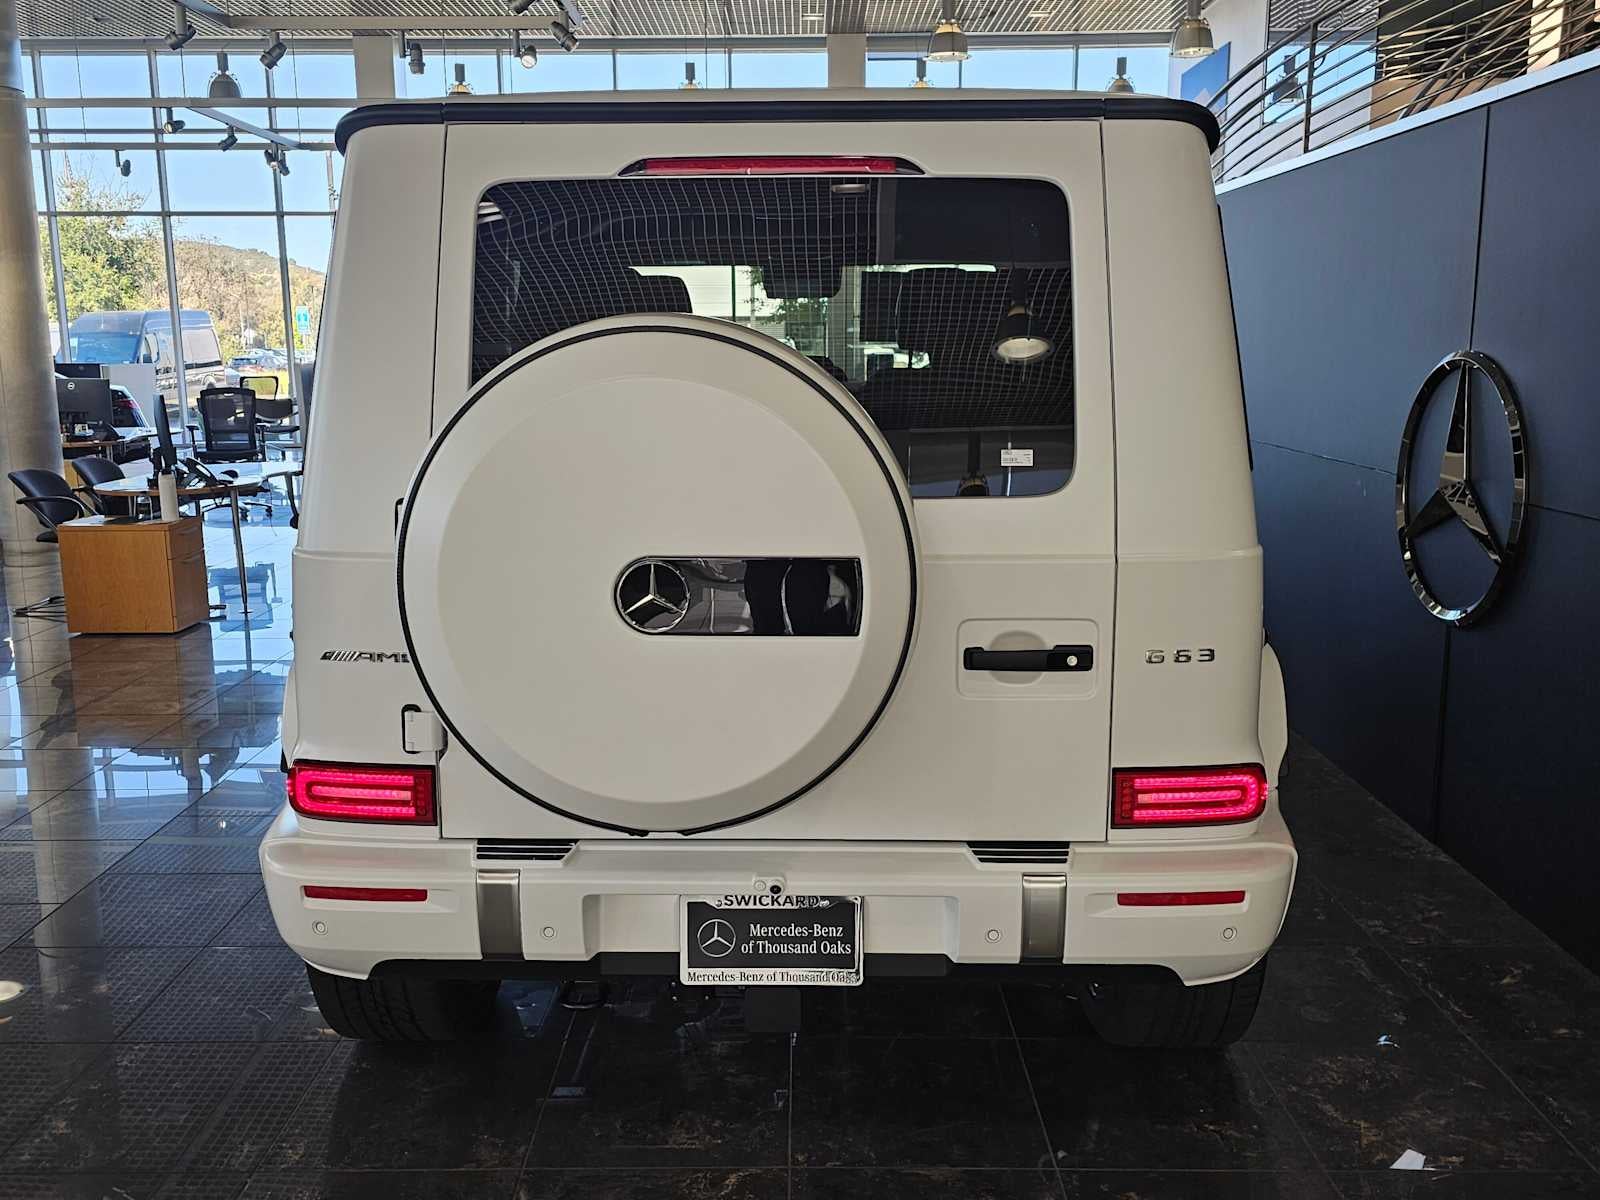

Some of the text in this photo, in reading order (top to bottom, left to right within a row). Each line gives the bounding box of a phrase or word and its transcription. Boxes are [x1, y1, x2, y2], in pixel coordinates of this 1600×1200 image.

[1145, 648, 1215, 664] G 63
[749, 923, 844, 937] Mercedes-Benz
[741, 940, 852, 954] of Thousand Oaks
[688, 971, 764, 982] Mercedes-Benz
[766, 971, 778, 982] of
[779, 971, 828, 983] Thousand
